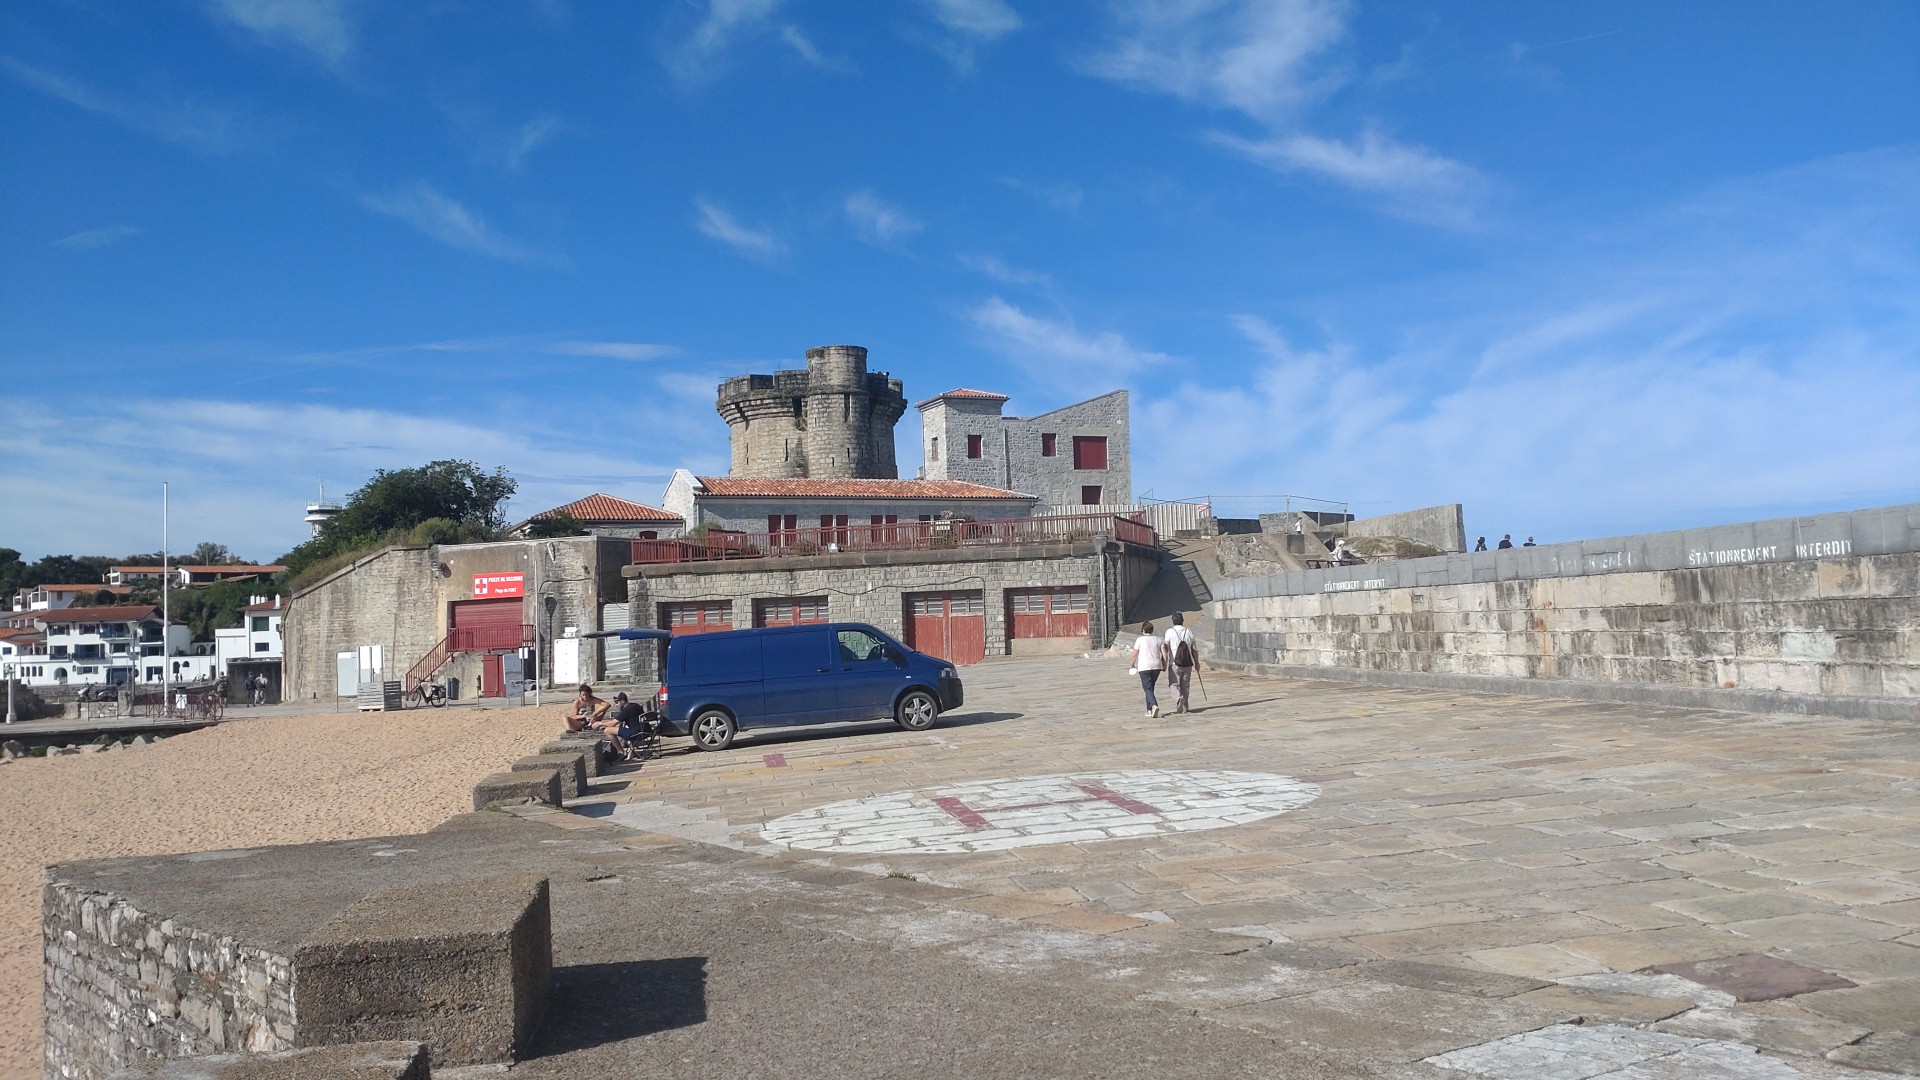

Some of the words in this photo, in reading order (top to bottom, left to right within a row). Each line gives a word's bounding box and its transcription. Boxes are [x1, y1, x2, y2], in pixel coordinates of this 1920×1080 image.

[1688, 546, 1777, 566] STATIONNEMENT
[1795, 540, 1853, 558] INTERDIT
[932, 784, 1162, 830] H
